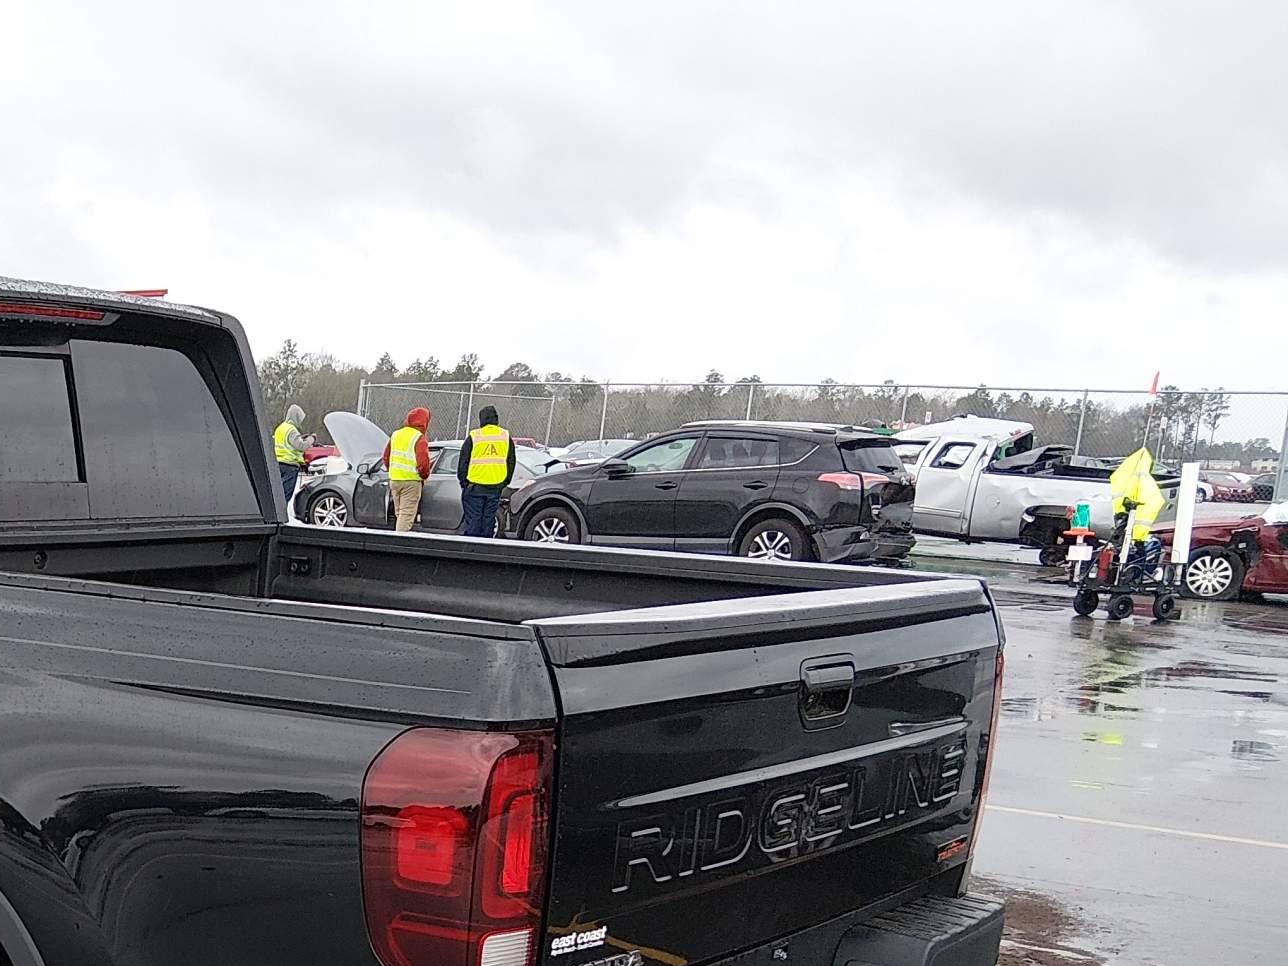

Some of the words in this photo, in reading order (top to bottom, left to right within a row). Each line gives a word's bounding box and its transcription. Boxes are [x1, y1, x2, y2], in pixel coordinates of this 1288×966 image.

[610, 742, 965, 894] RIDGELINE
[551, 932, 577, 950] east
[576, 925, 608, 944] coast
